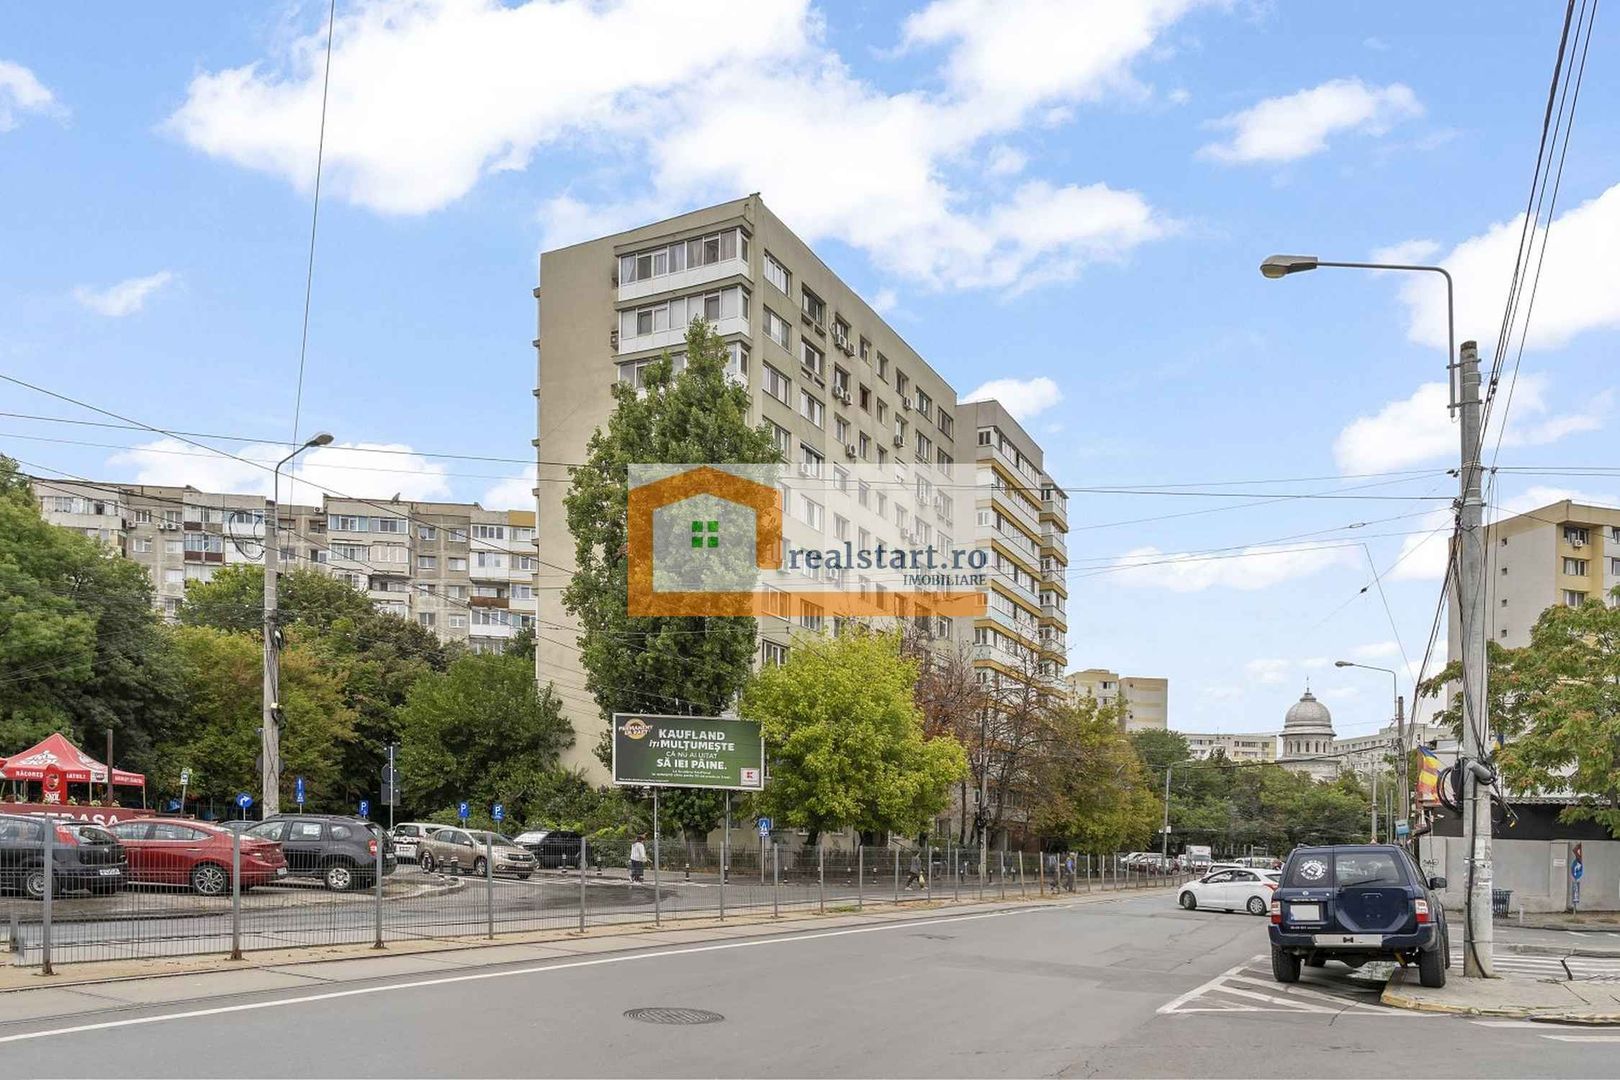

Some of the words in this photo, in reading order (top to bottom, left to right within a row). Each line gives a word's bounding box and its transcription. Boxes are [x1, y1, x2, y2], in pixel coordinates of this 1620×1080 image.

[658, 729, 726, 741] KAUFLAND
[656, 756, 672, 768] SĂ
[674, 759, 688, 768] IEI
